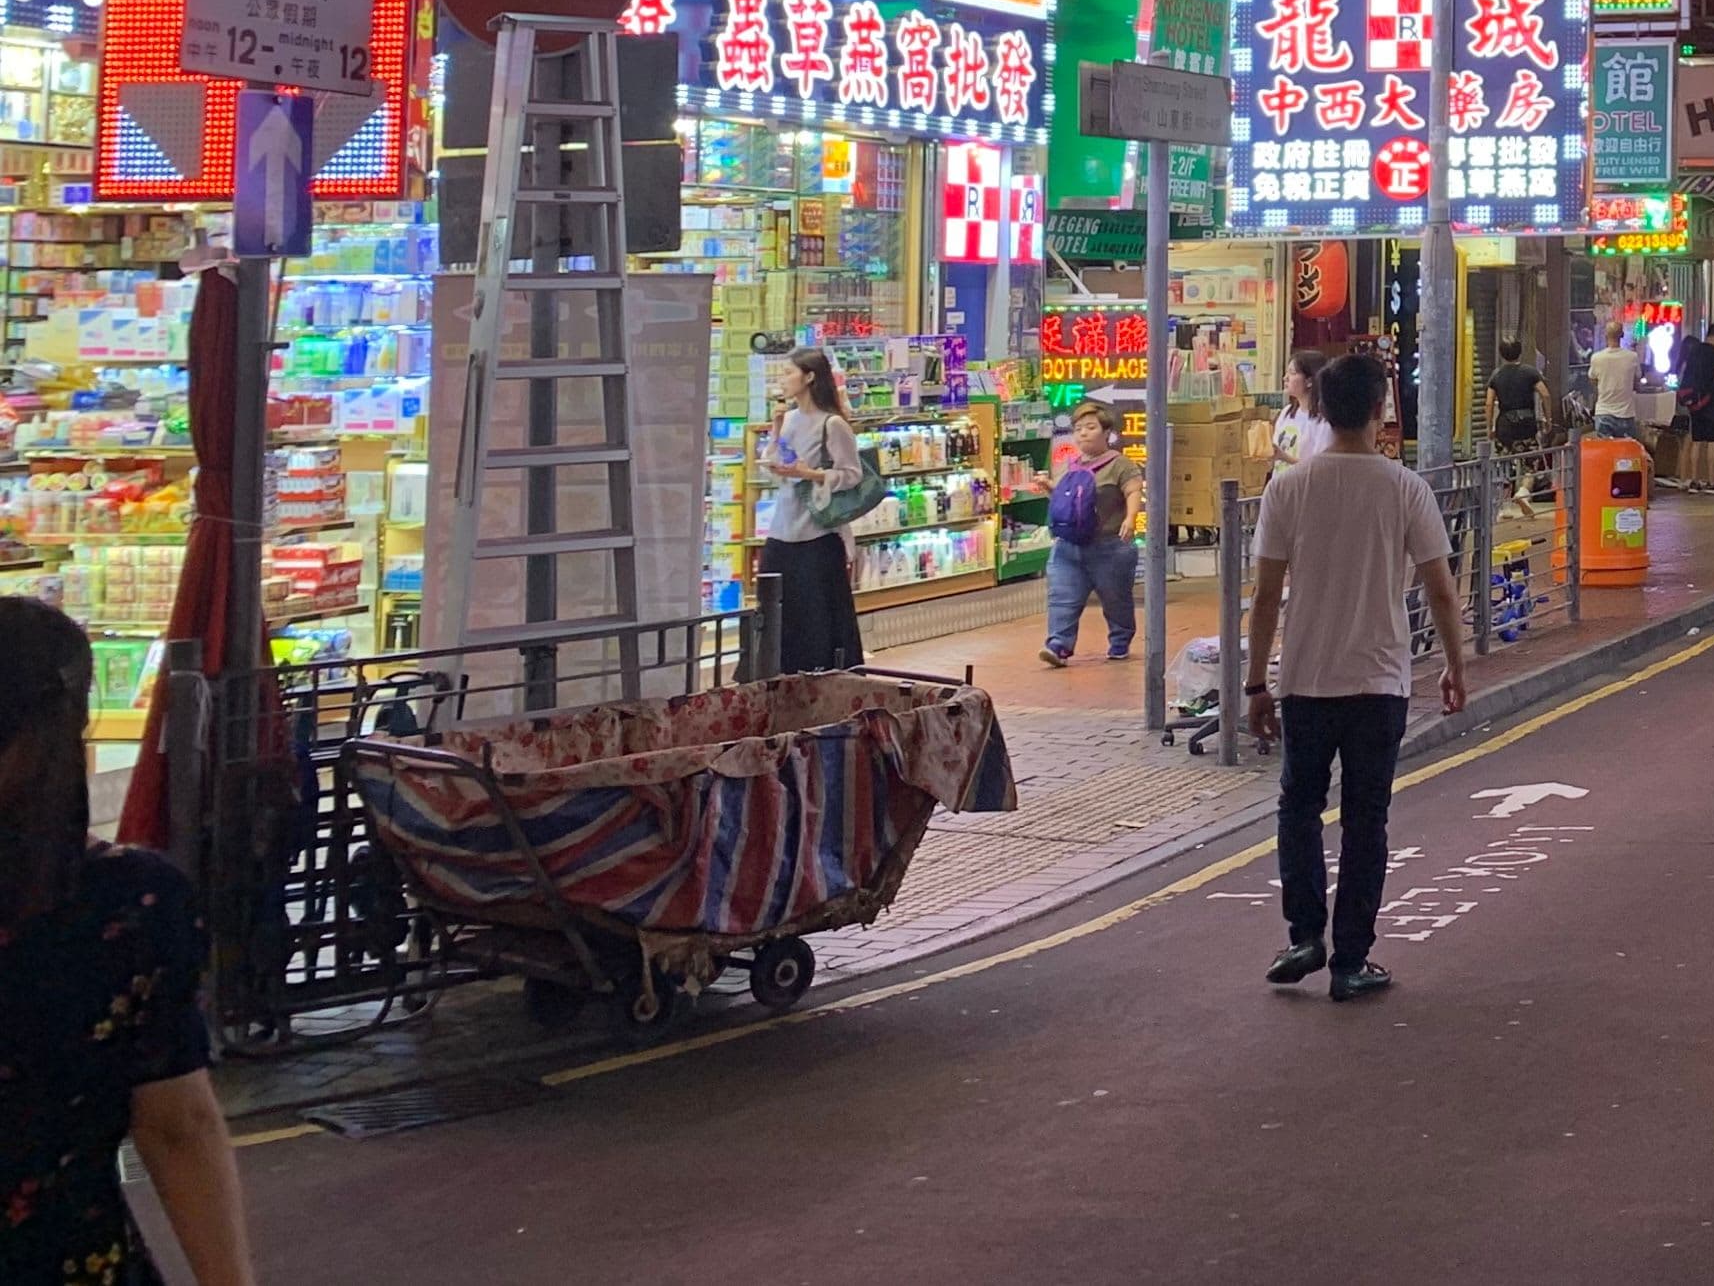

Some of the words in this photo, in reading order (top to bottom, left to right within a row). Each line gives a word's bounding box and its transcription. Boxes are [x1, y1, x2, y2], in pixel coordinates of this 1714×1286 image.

[279, 32, 334, 53] midnight
[340, 44, 369, 82] 12
[1602, 51, 1660, 105] 館
[1257, 69, 1556, 136] 中西大藥房
[1593, 111, 1662, 133] OTEL
[1596, 167, 1626, 176] FREE
[1630, 166, 1660, 175] WIFI
[1047, 215, 1101, 235] REGENG
